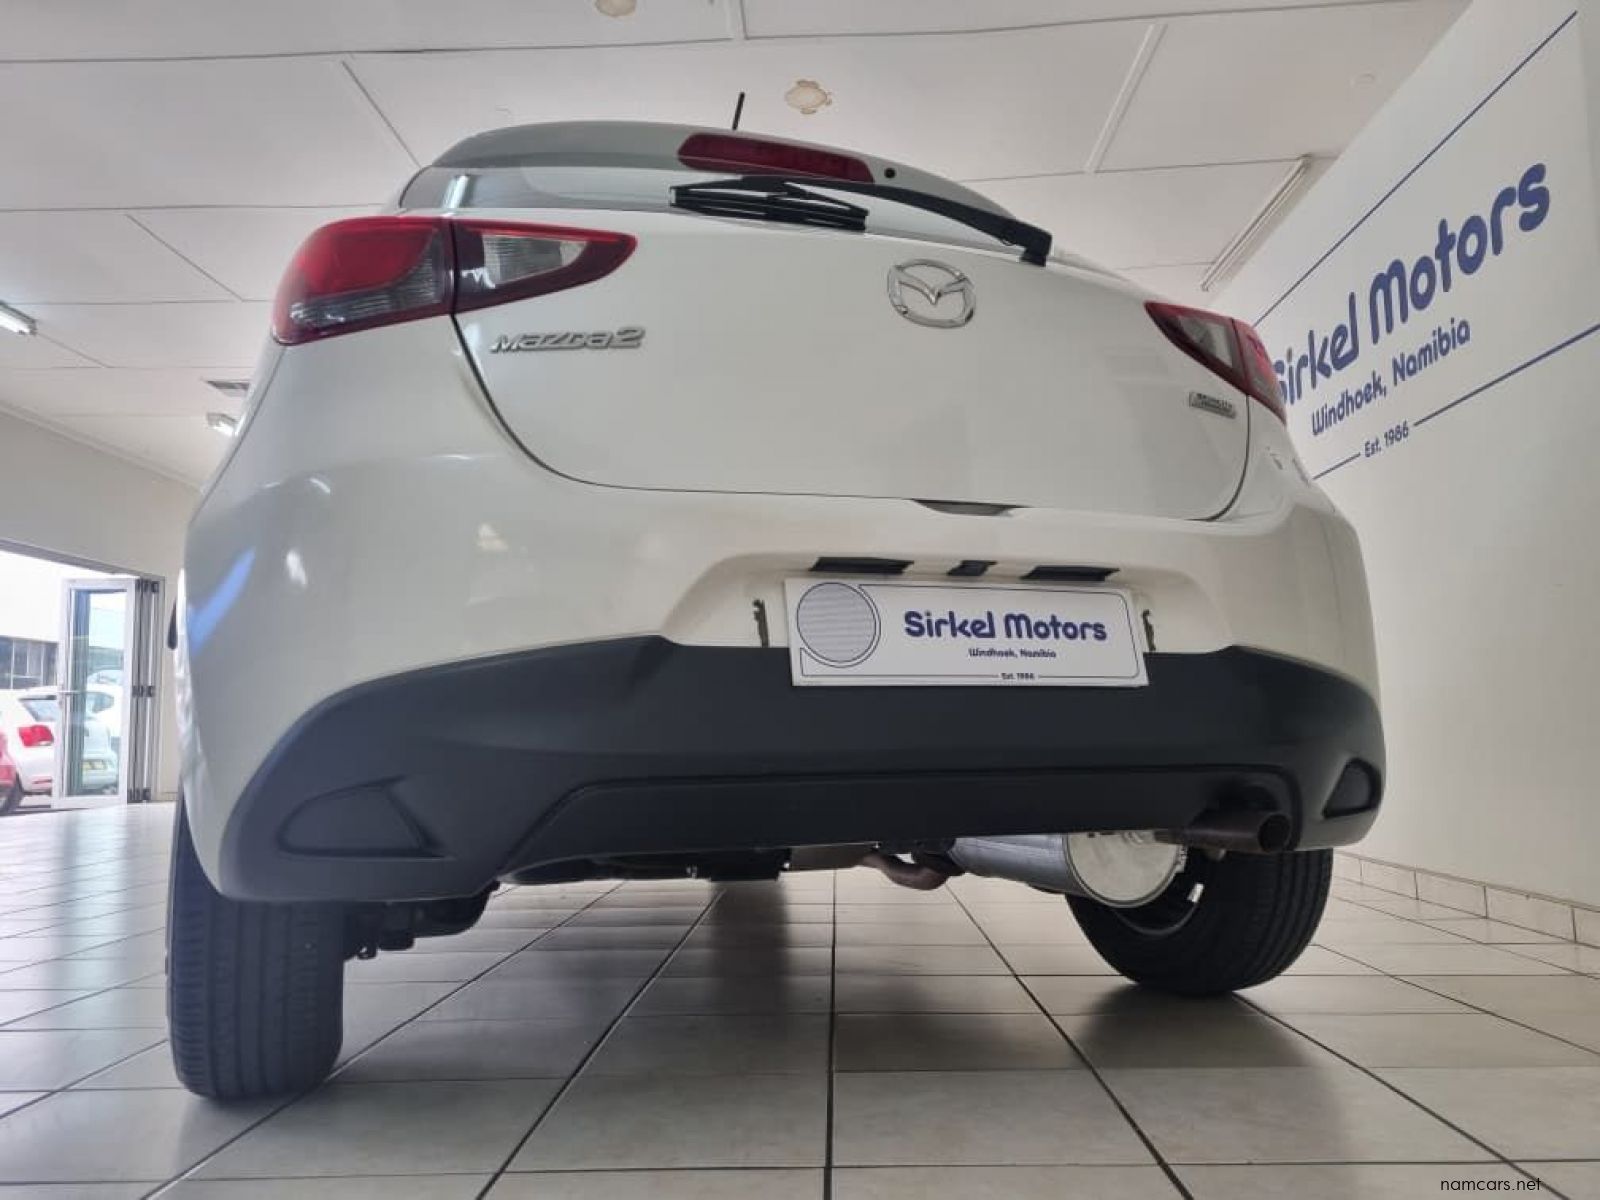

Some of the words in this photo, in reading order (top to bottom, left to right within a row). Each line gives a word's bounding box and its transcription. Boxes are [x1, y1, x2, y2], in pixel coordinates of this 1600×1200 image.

[1369, 162, 1550, 345] Motors
[1312, 369, 1387, 436] Windhoek,
[1392, 316, 1471, 387] Namibia
[1364, 437, 1382, 458] Est.
[1383, 420, 1409, 447] 1986
[903, 610, 996, 639] Sirkel
[1004, 612, 1108, 641] Motors
